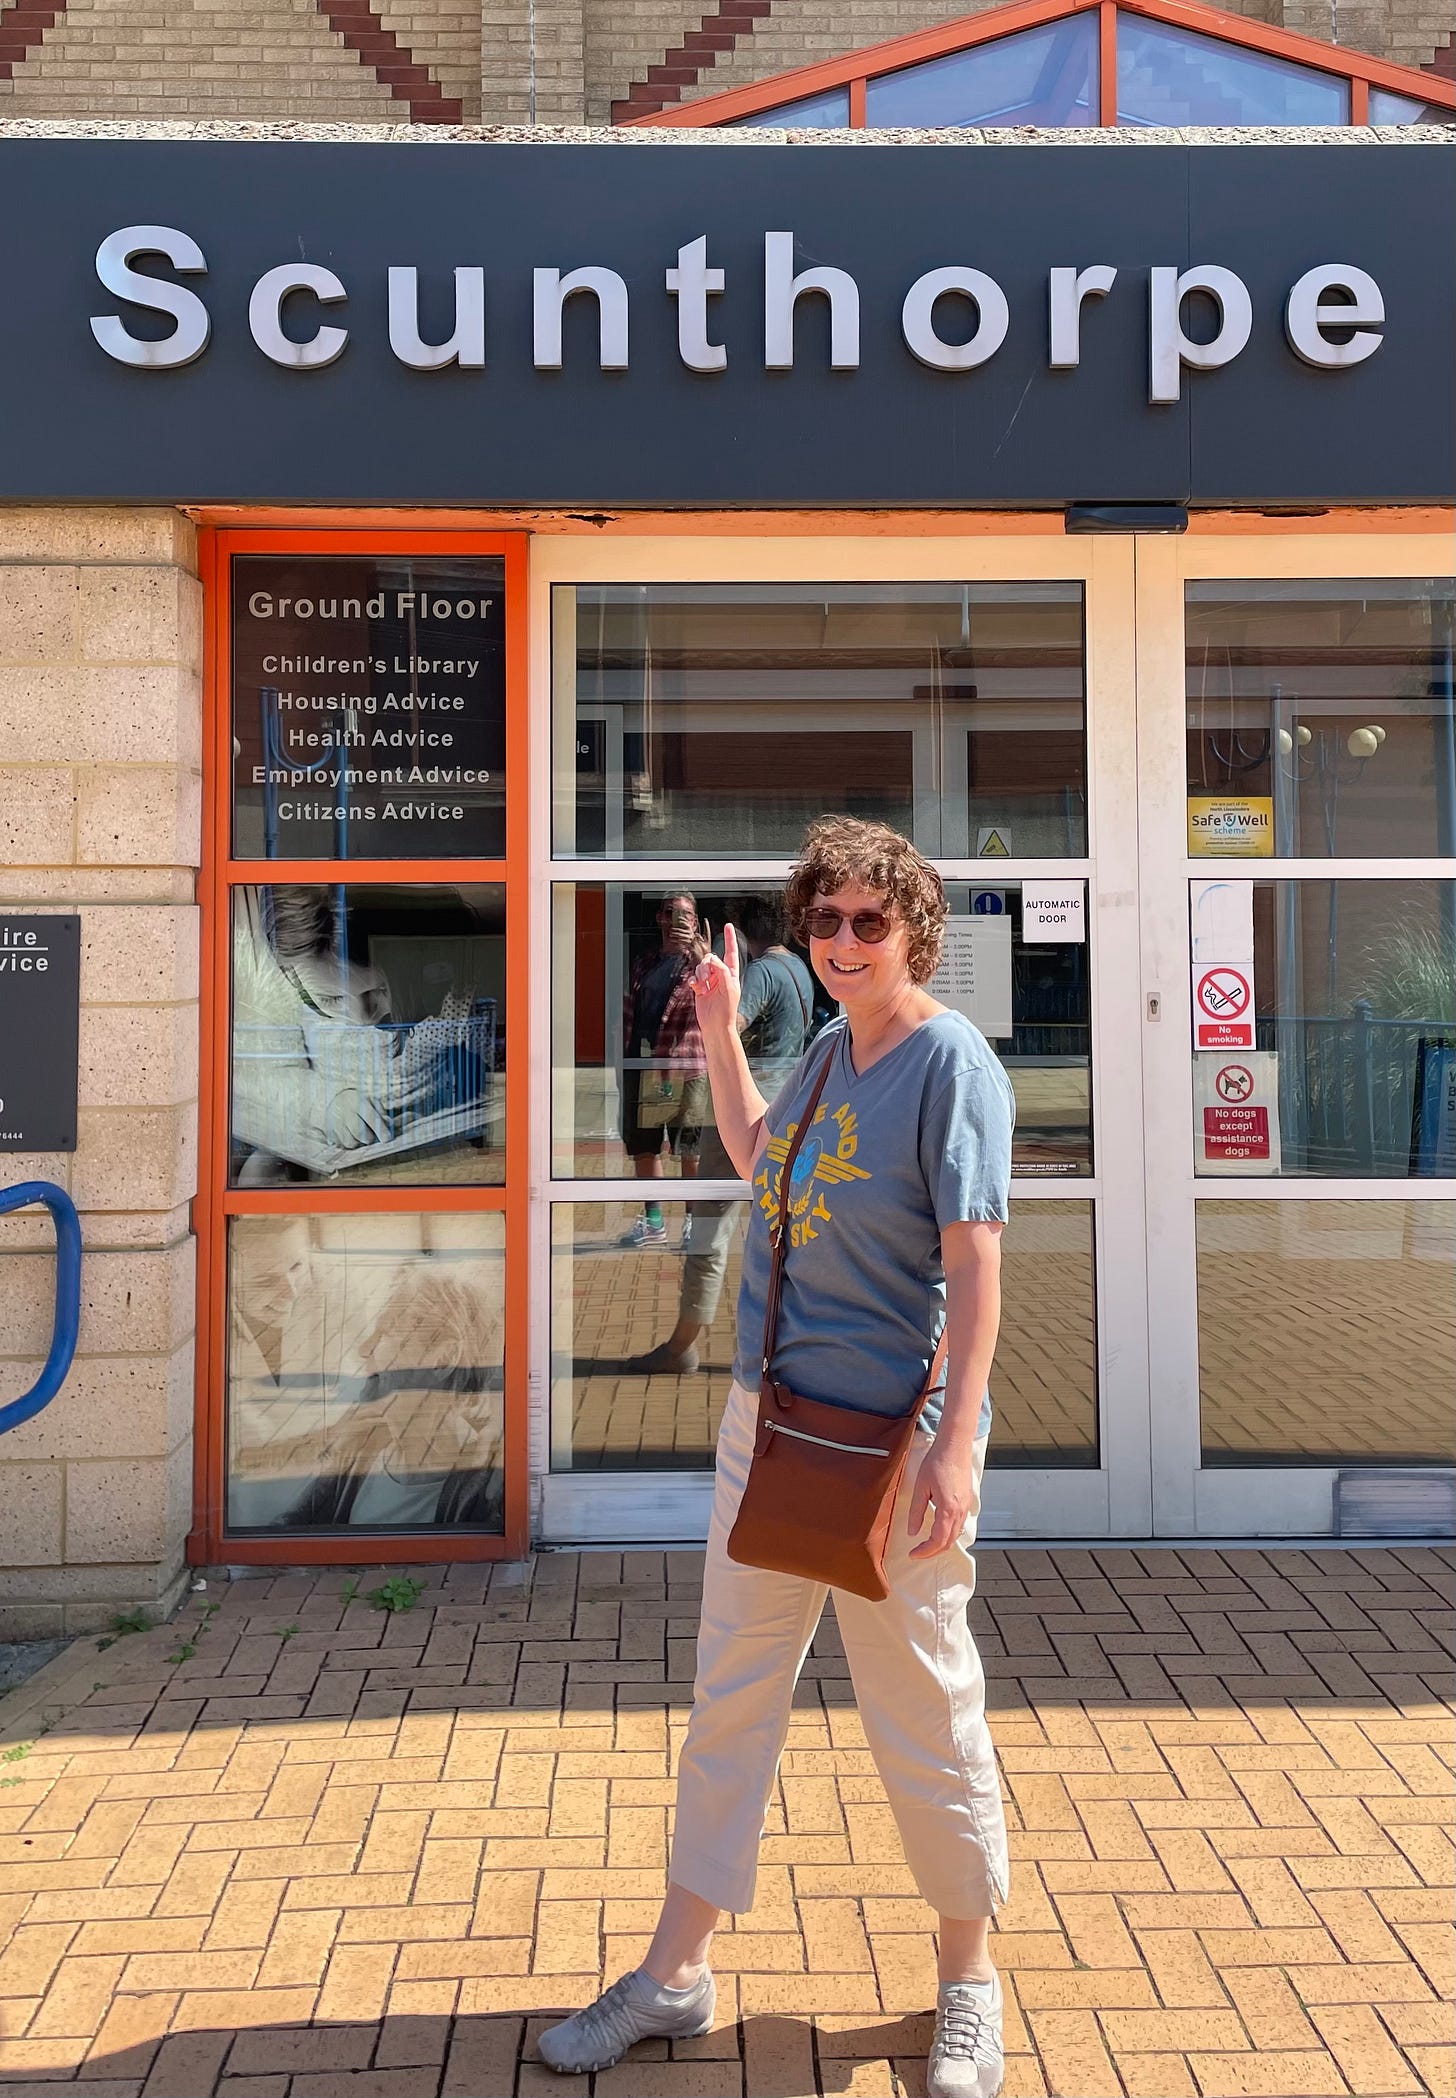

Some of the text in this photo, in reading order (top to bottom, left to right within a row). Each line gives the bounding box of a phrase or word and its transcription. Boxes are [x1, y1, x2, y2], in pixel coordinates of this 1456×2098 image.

[90, 225, 1386, 403] Scunthorpe
[249, 592, 493, 619] Ground Floor
[262, 655, 480, 678] Children’s Library
[277, 692, 466, 715] Housing Advice
[289, 729, 454, 747] Health Advice
[252, 765, 490, 788] Employment Advice
[277, 802, 465, 821] Citizens Advice
[1192, 814, 1221, 826] Safe
[1237, 814, 1269, 826] Well
[1213, 826, 1247, 835] scheme
[1025, 900, 1081, 909] AUTOMATIC
[1038, 914, 1067, 924] DOOR
[3, 927, 37, 946] ire
[1218, 1025, 1232, 1034] No
[1207, 1036, 1244, 1045] smoking
[1215, 1109, 1257, 1120] No dogs
[830, 1102, 860, 1161] AND
[1219, 1122, 1254, 1132] except
[1210, 1134, 1264, 1143] assistance
[1224, 1146, 1250, 1158] dogs
[790, 1192, 832, 1249] SKY
